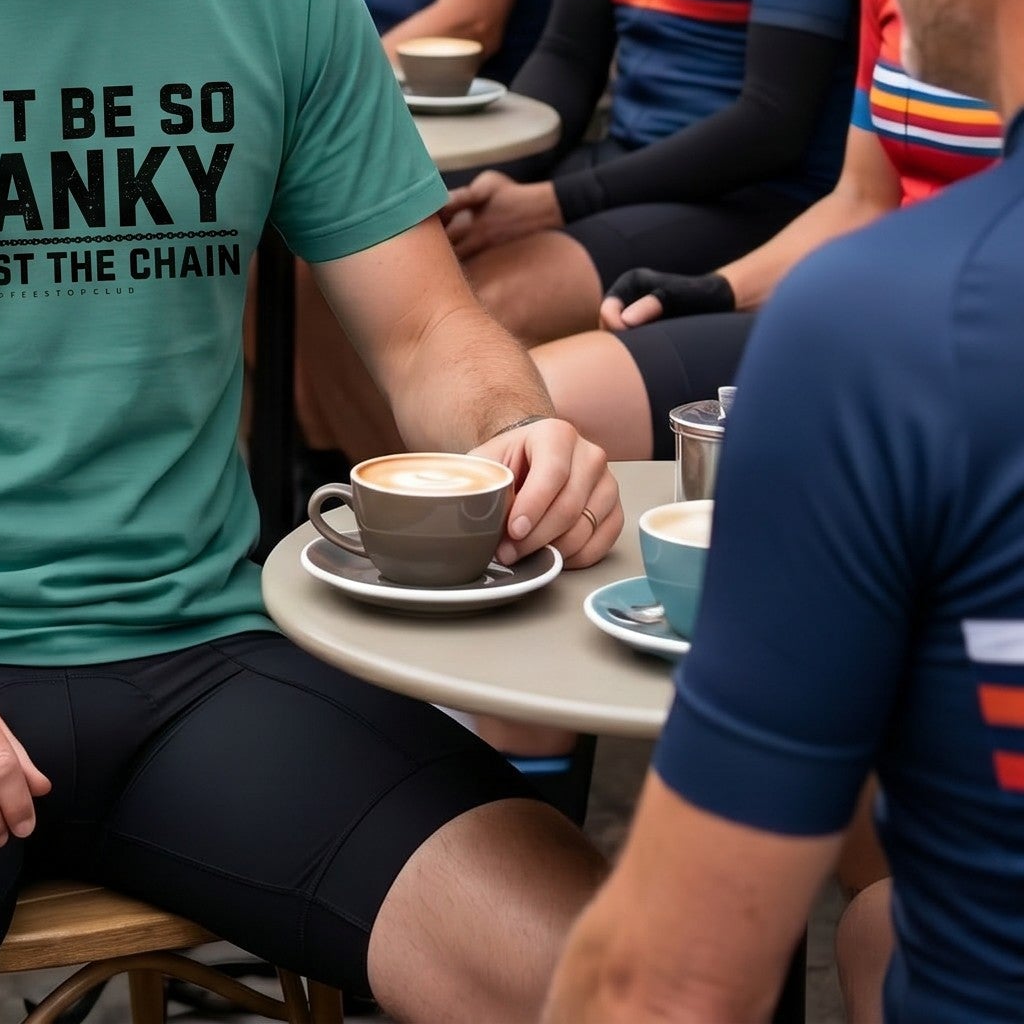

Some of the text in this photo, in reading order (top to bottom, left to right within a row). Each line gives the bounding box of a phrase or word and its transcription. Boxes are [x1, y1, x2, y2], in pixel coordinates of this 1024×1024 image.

[60, 85, 135, 140] BE
[159, 81, 235, 136] SO
[46, 249, 116, 284] THE
[129, 243, 241, 280] CHAIN
